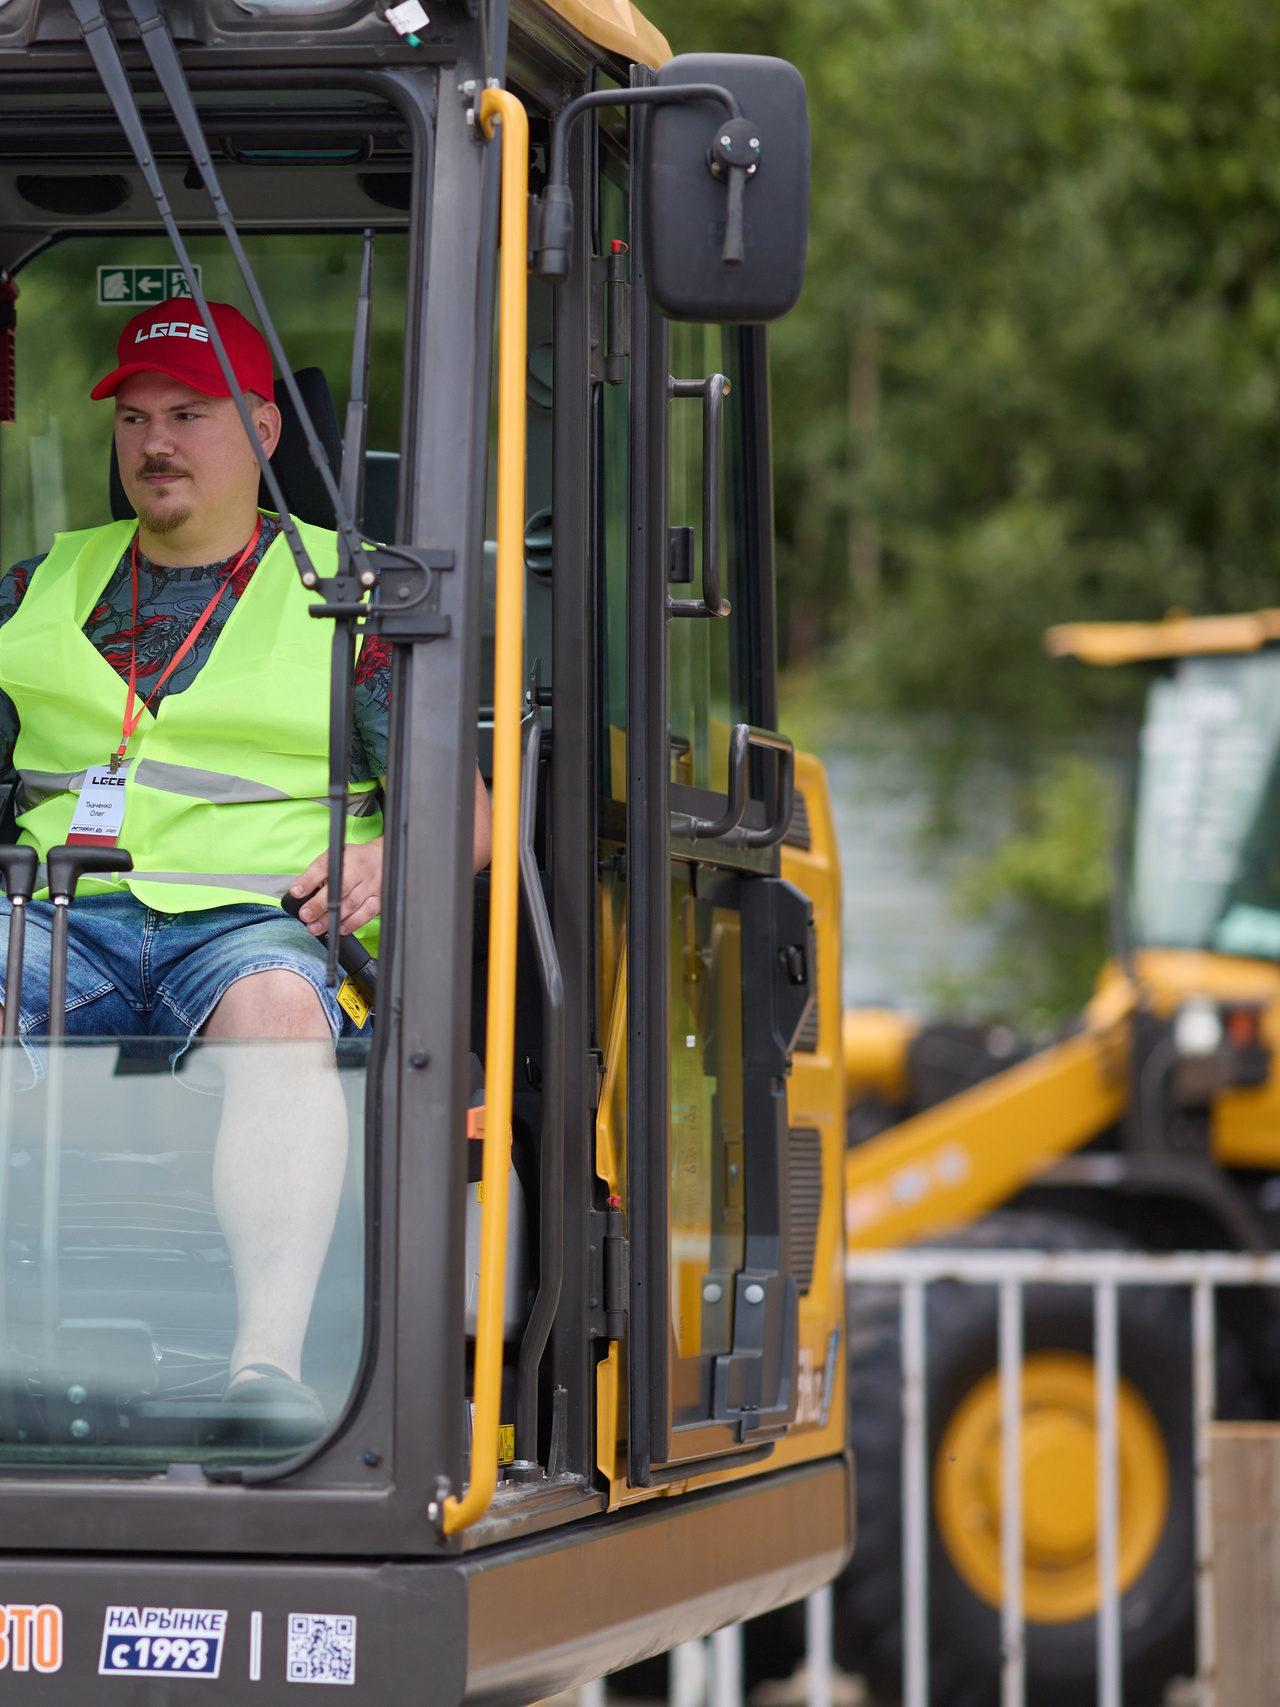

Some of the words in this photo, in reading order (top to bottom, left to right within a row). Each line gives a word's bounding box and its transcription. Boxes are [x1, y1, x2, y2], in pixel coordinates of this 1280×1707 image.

[134, 322, 209, 343] LGCE
[92, 777, 126, 786] LGCE
[108, 1610, 138, 1628] НА
[143, 1612, 225, 1631] РЫНКЕ
[134, 1637, 210, 1670] 1993
